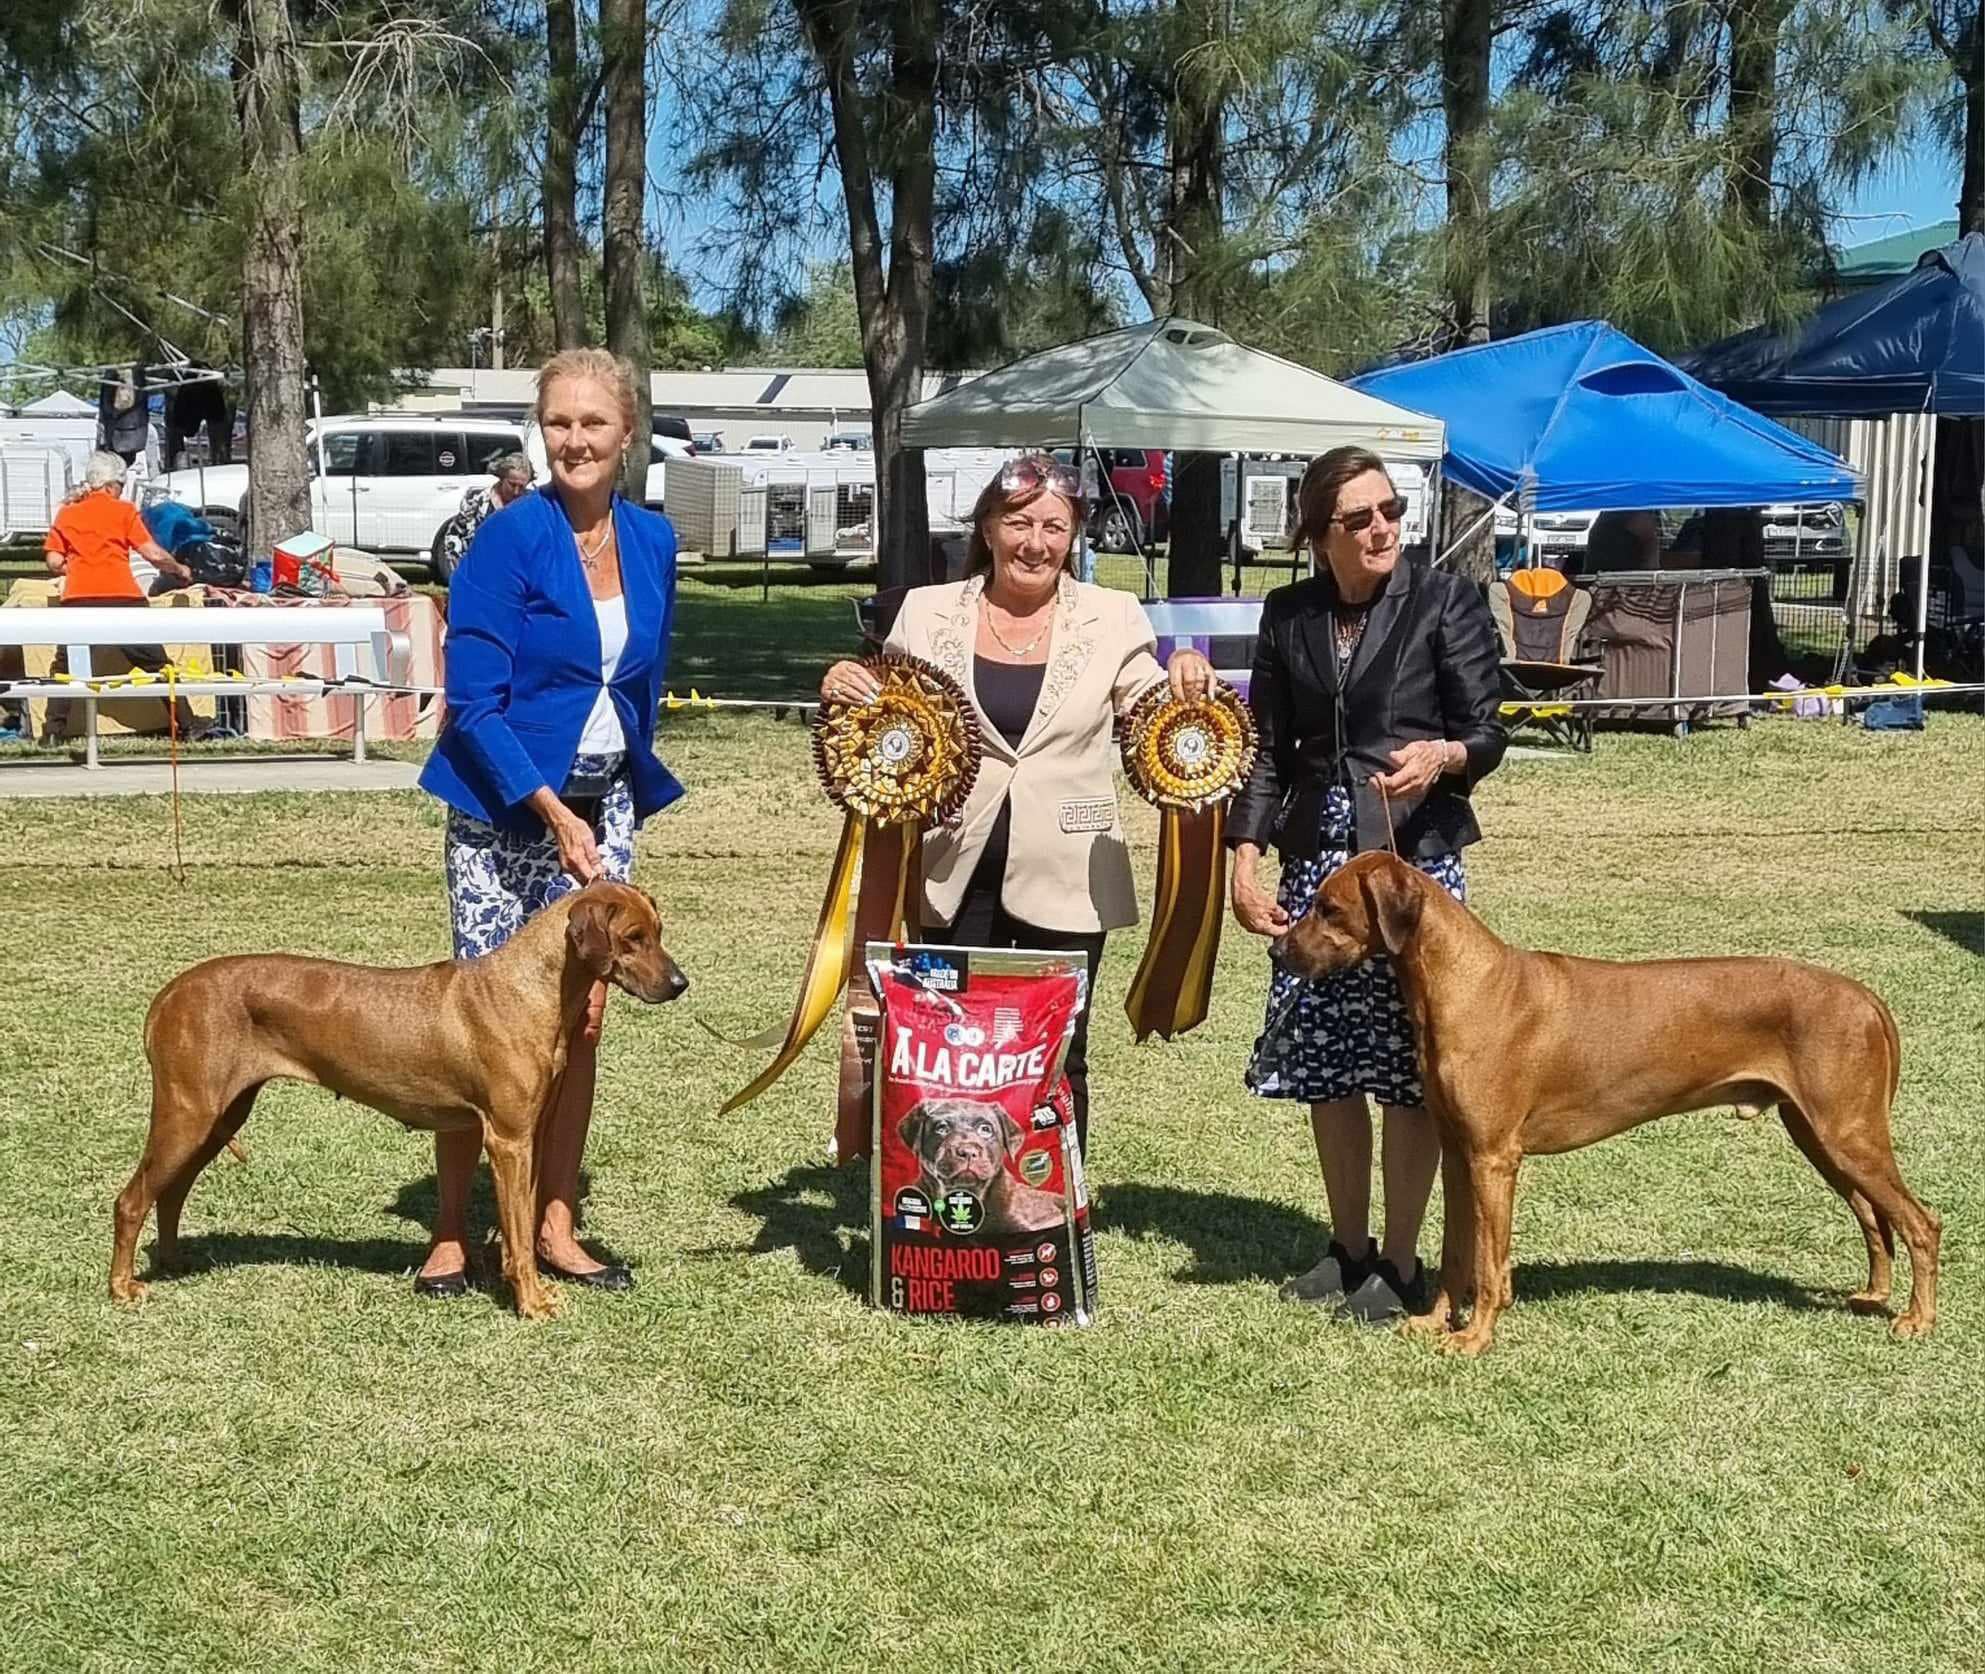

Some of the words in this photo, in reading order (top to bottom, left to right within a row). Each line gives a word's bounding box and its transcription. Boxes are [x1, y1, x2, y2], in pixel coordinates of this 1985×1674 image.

[916, 1041, 952, 1084] LA
[957, 1043, 1048, 1088] CARTE
[890, 1243, 1001, 1280] KANGAROO
[891, 1276, 905, 1308] &
[908, 1279, 955, 1312] RICE
